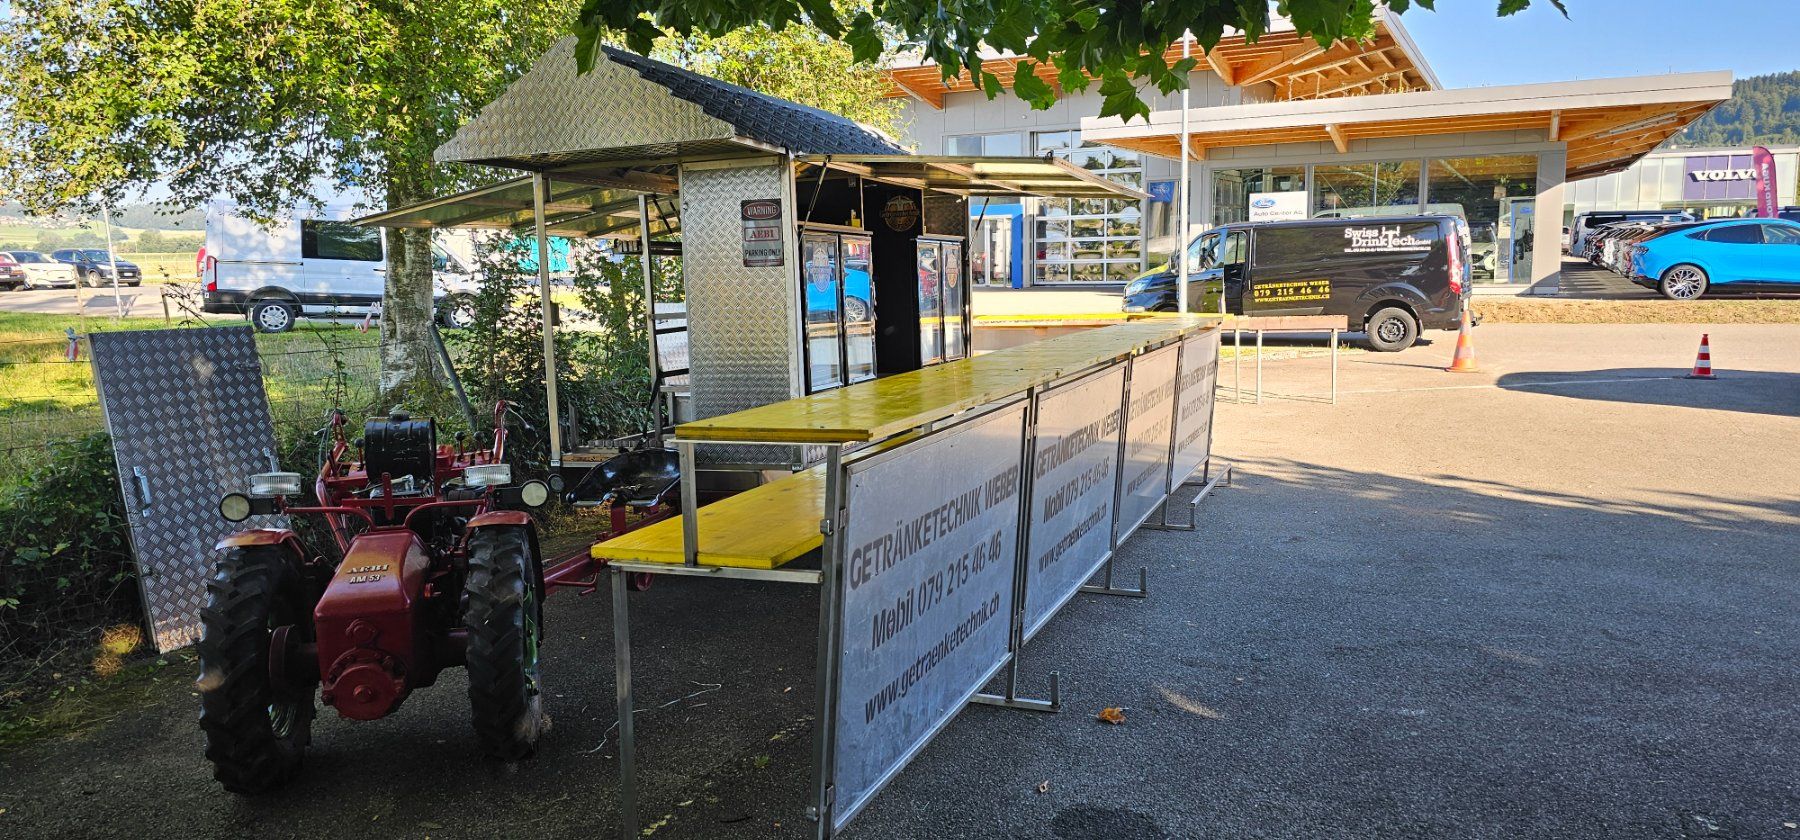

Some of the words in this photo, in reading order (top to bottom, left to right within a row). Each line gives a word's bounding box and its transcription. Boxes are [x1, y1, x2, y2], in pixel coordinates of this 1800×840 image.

[1692, 169, 1757, 181] VOLV
[747, 205, 777, 216] WARNING
[750, 229, 774, 238] AEBI
[1344, 227, 1378, 238] Swiss
[745, 248, 767, 256] PARKING
[1254, 289, 1270, 297] 079
[1277, 287, 1294, 296] 215
[1300, 286, 1312, 294] 46
[1318, 285, 1330, 293] 46
[1035, 420, 1100, 480] GETRÄNKETECHNIK
[1101, 408, 1120, 439] WEBER
[1043, 482, 1065, 524] Mobil
[1065, 475, 1079, 507] 079
[1079, 467, 1092, 497] 215
[850, 485, 982, 591] GETRÄNKETECHNIK
[984, 464, 1019, 511] WEBER
[350, 576, 367, 584] AM
[369, 574, 381, 582] 53
[872, 588, 914, 651] Mobil
[918, 569, 943, 617] 079
[947, 553, 969, 597] 215
[972, 541, 986, 575] 46
[988, 529, 1002, 563] 46
[865, 591, 999, 725] www.getraenketechnik.ch
